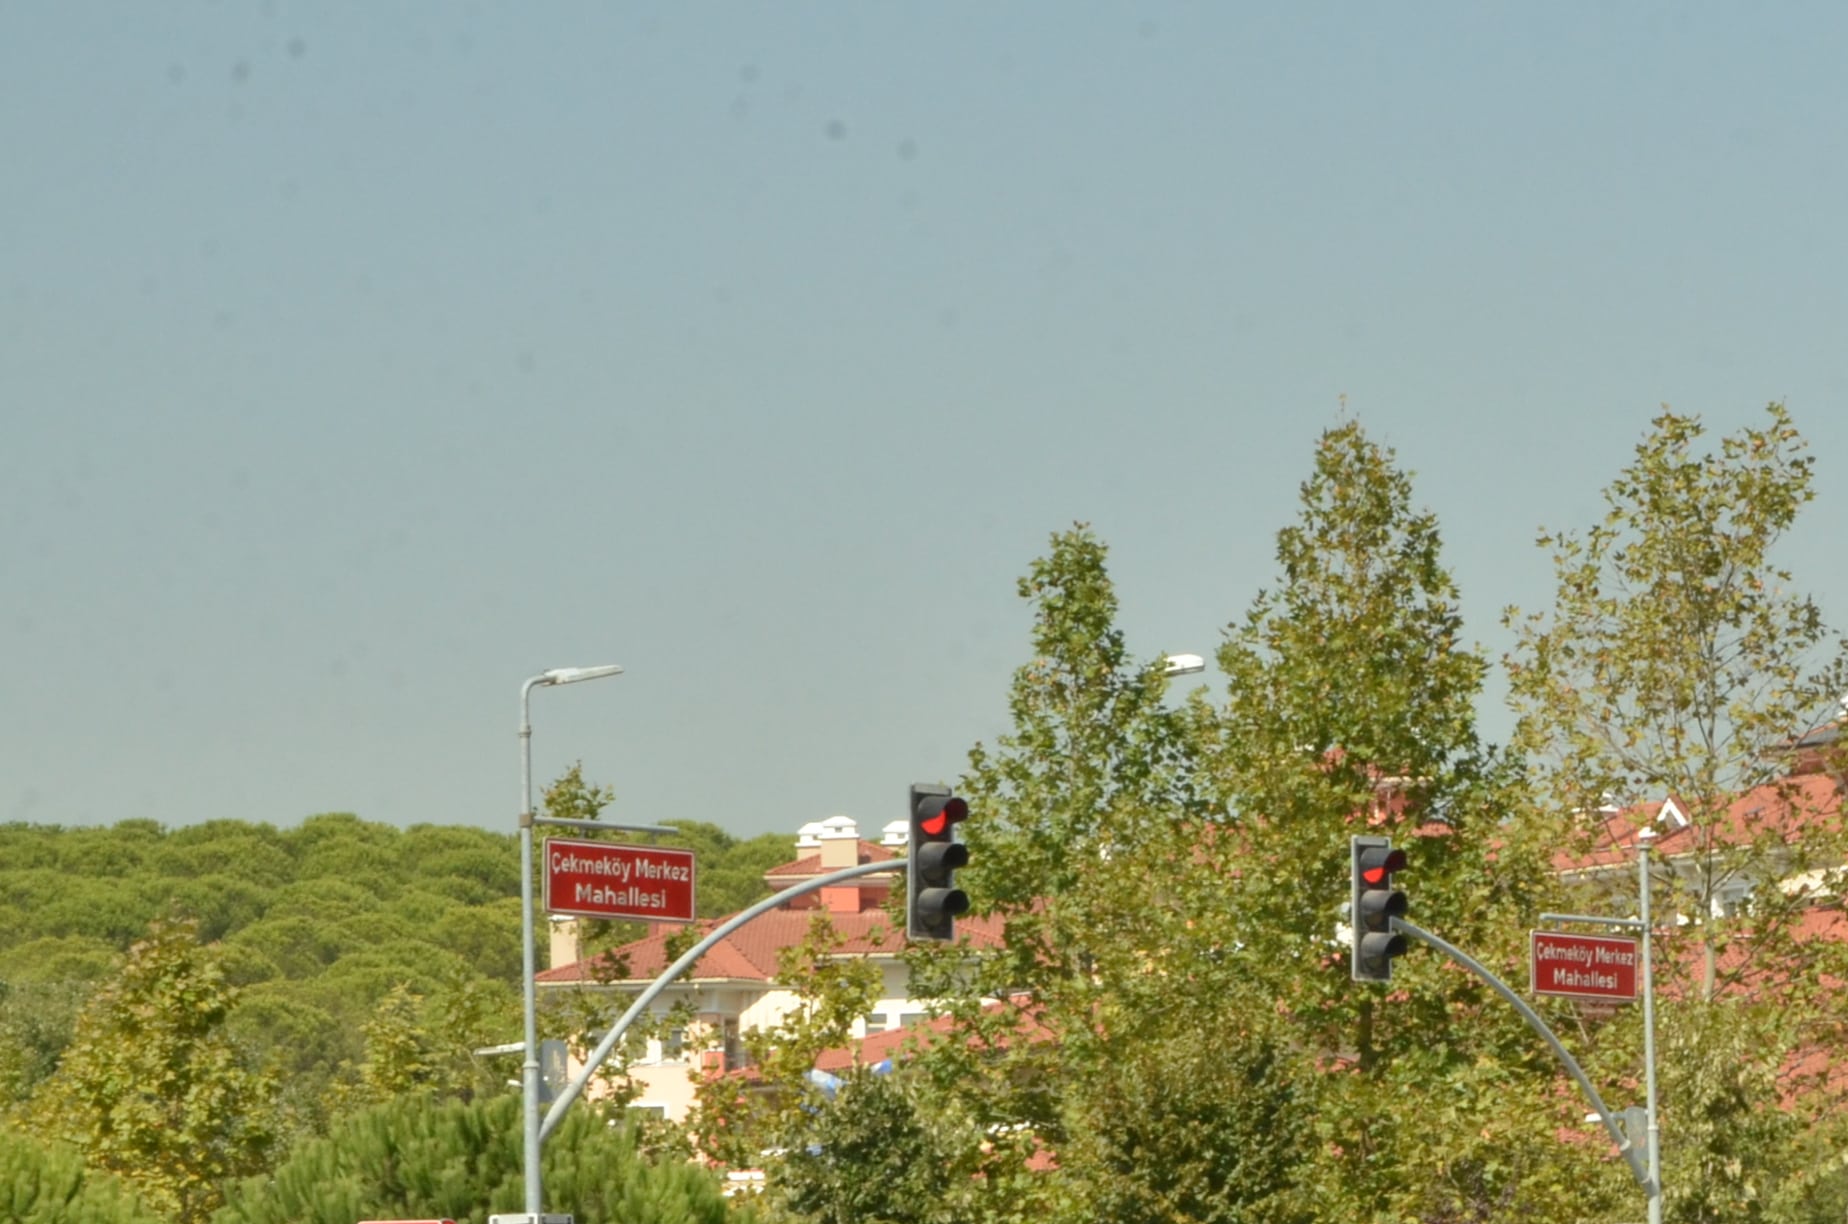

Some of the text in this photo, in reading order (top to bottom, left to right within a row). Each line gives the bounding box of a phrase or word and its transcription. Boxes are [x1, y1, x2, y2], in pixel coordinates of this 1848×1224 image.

[552, 852, 689, 883] Çekmeköy Merkez
[575, 883, 666, 909] Mahallesi
[1553, 967, 1618, 989] Mahallesi
